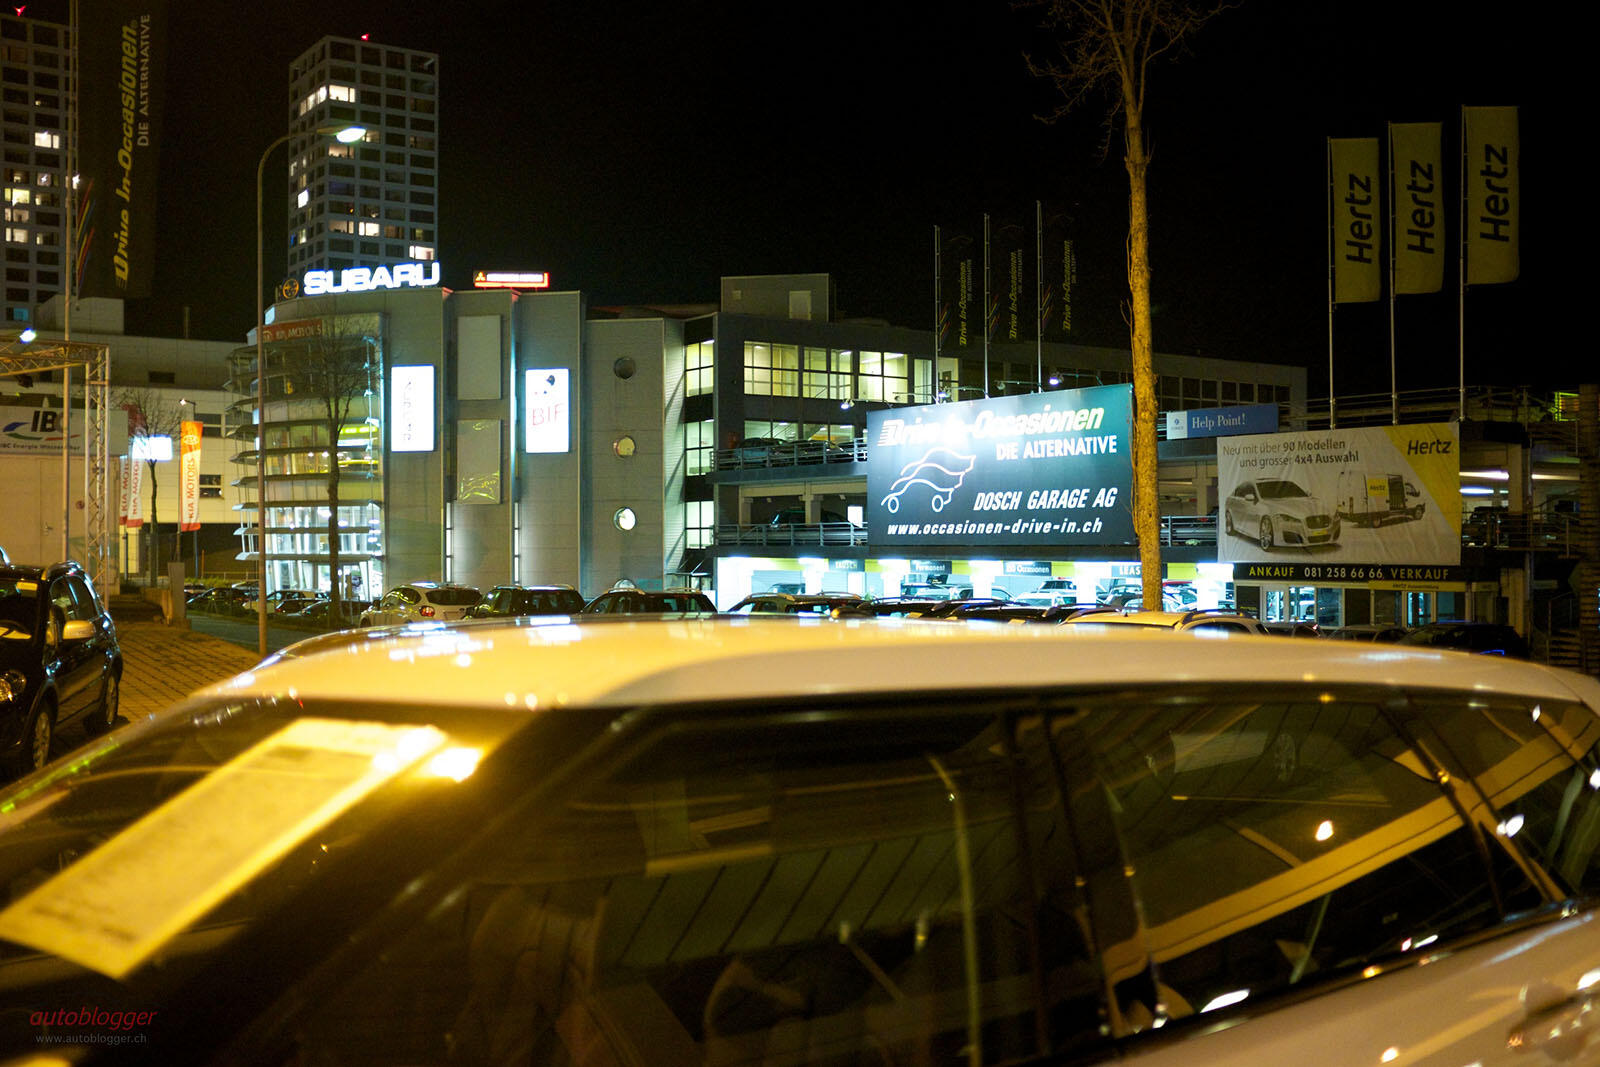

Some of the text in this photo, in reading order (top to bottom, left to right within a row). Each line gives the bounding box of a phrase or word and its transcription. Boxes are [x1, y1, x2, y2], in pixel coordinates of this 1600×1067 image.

[137, 14, 151, 148] DIE ALTERNATIVE
[1480, 143, 1510, 243] Hertz
[1345, 173, 1373, 265] Hertz
[1406, 159, 1435, 255] Hertz
[113, 207, 129, 288] Drive
[303, 261, 441, 296] SUBARU
[1191, 412, 1246, 431] Help Point!
[996, 435, 1118, 461] DIE ALTERNATIVE
[1223, 439, 1346, 456] Neu mit über 90 Modellen
[1240, 457, 1257, 468] und
[1295, 454, 1313, 464] 4x4
[1315, 450, 1360, 464] Auswahl
[1407, 438, 1452, 456] Hertz
[972, 486, 1119, 511] DOSCH GARAGE AG
[887, 517, 1103, 536] www.occasionen-drive-in.ch
[1119, 565, 1142, 576] LEAS
[1248, 566, 1449, 580] ANKAUF 081 258 66 66 VERKAUF
